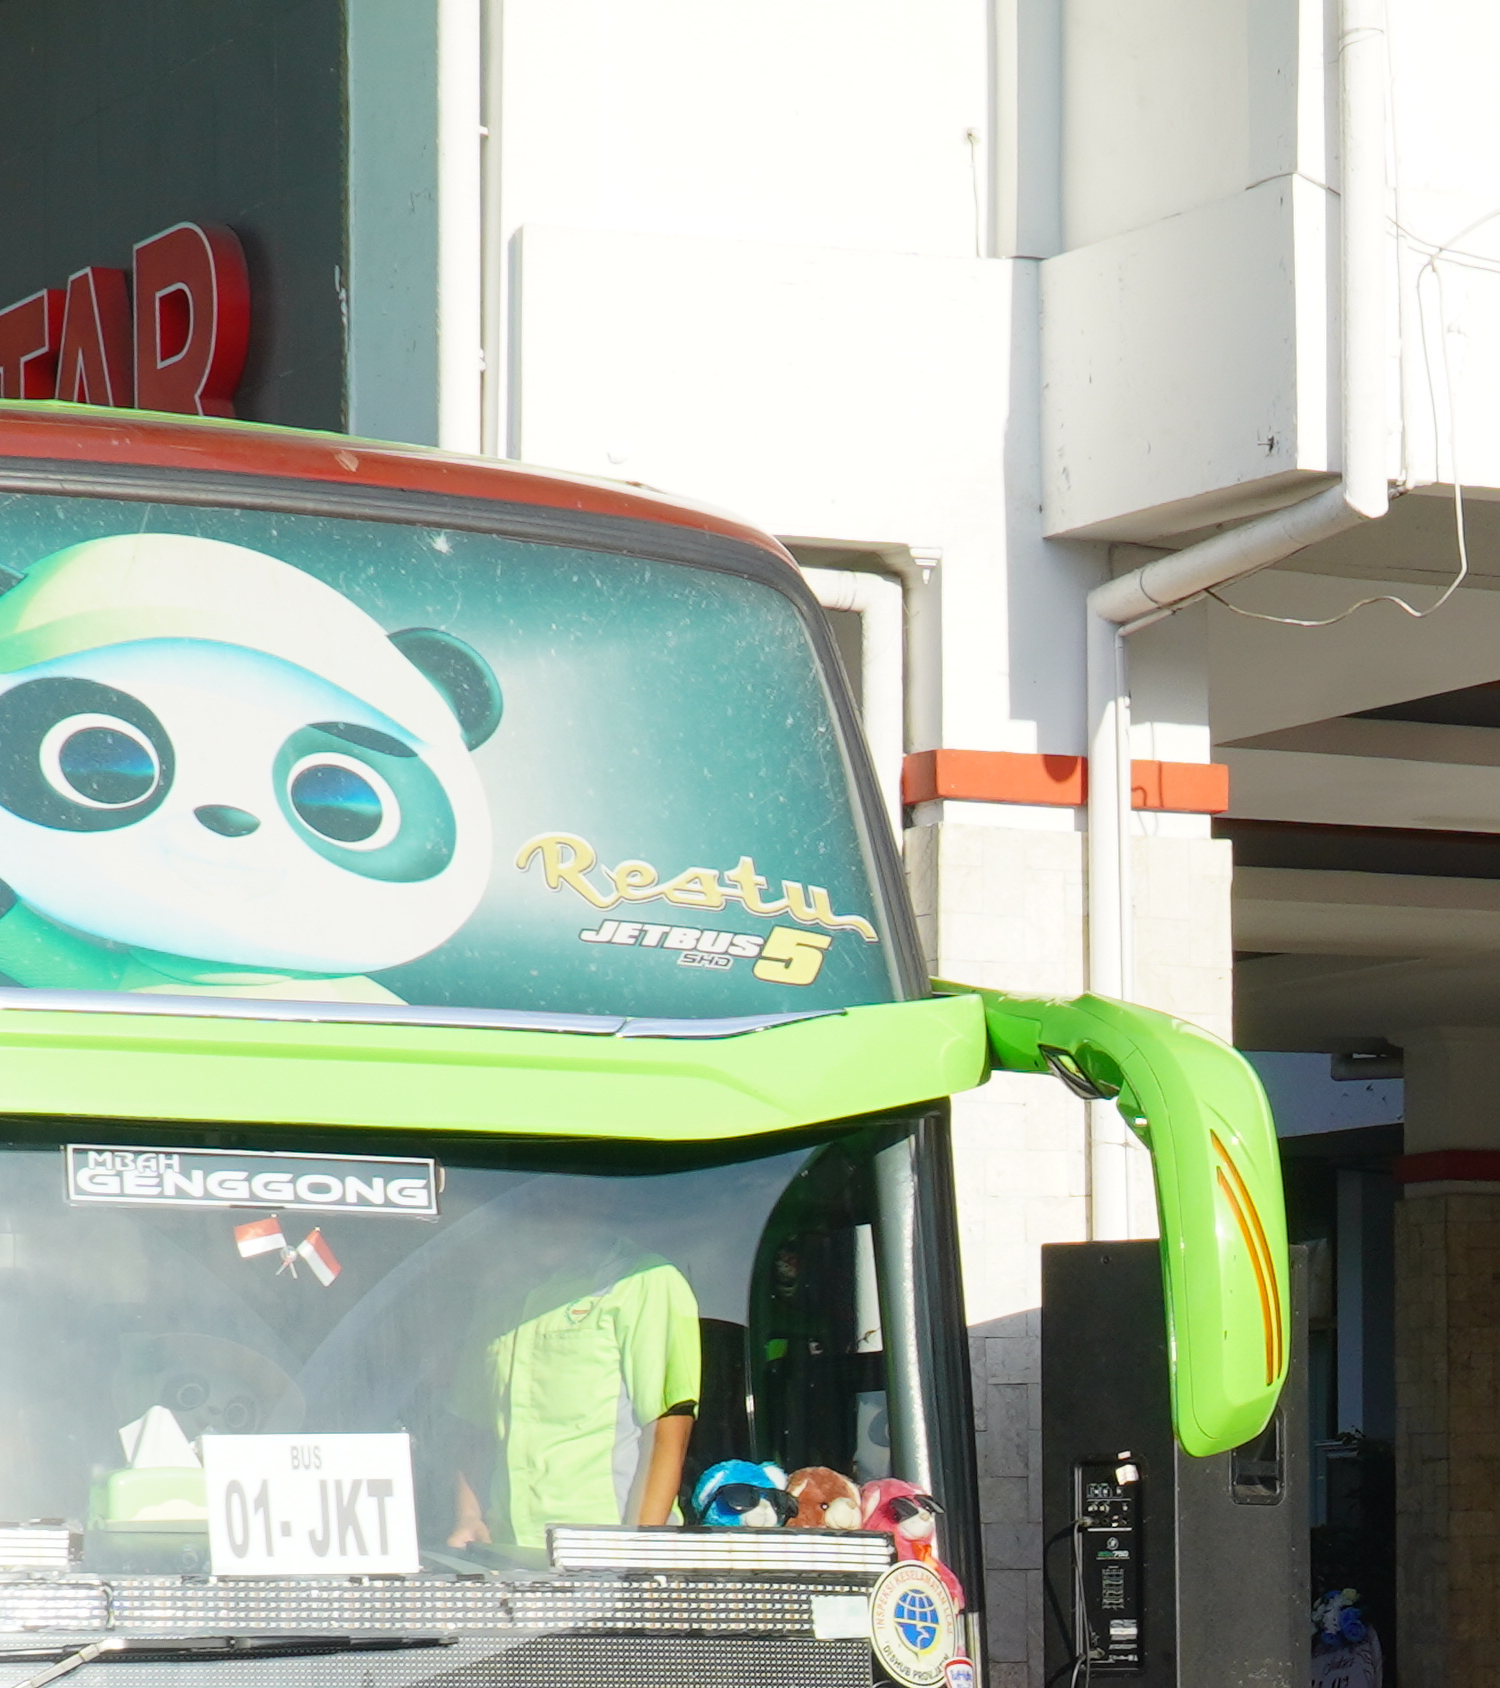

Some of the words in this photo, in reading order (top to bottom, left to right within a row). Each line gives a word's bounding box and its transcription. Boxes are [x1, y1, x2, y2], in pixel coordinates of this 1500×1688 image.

[514, 831, 879, 942] Restu
[580, 919, 764, 957] JETBUS
[753, 926, 832, 986] 5
[677, 953, 732, 971] SHD
[88, 1151, 180, 1174] MBAH
[76, 1167, 429, 1207] GENGGONG
[291, 1446, 322, 1470] BUS
[877, 1581, 894, 1629] INSPEKSI
